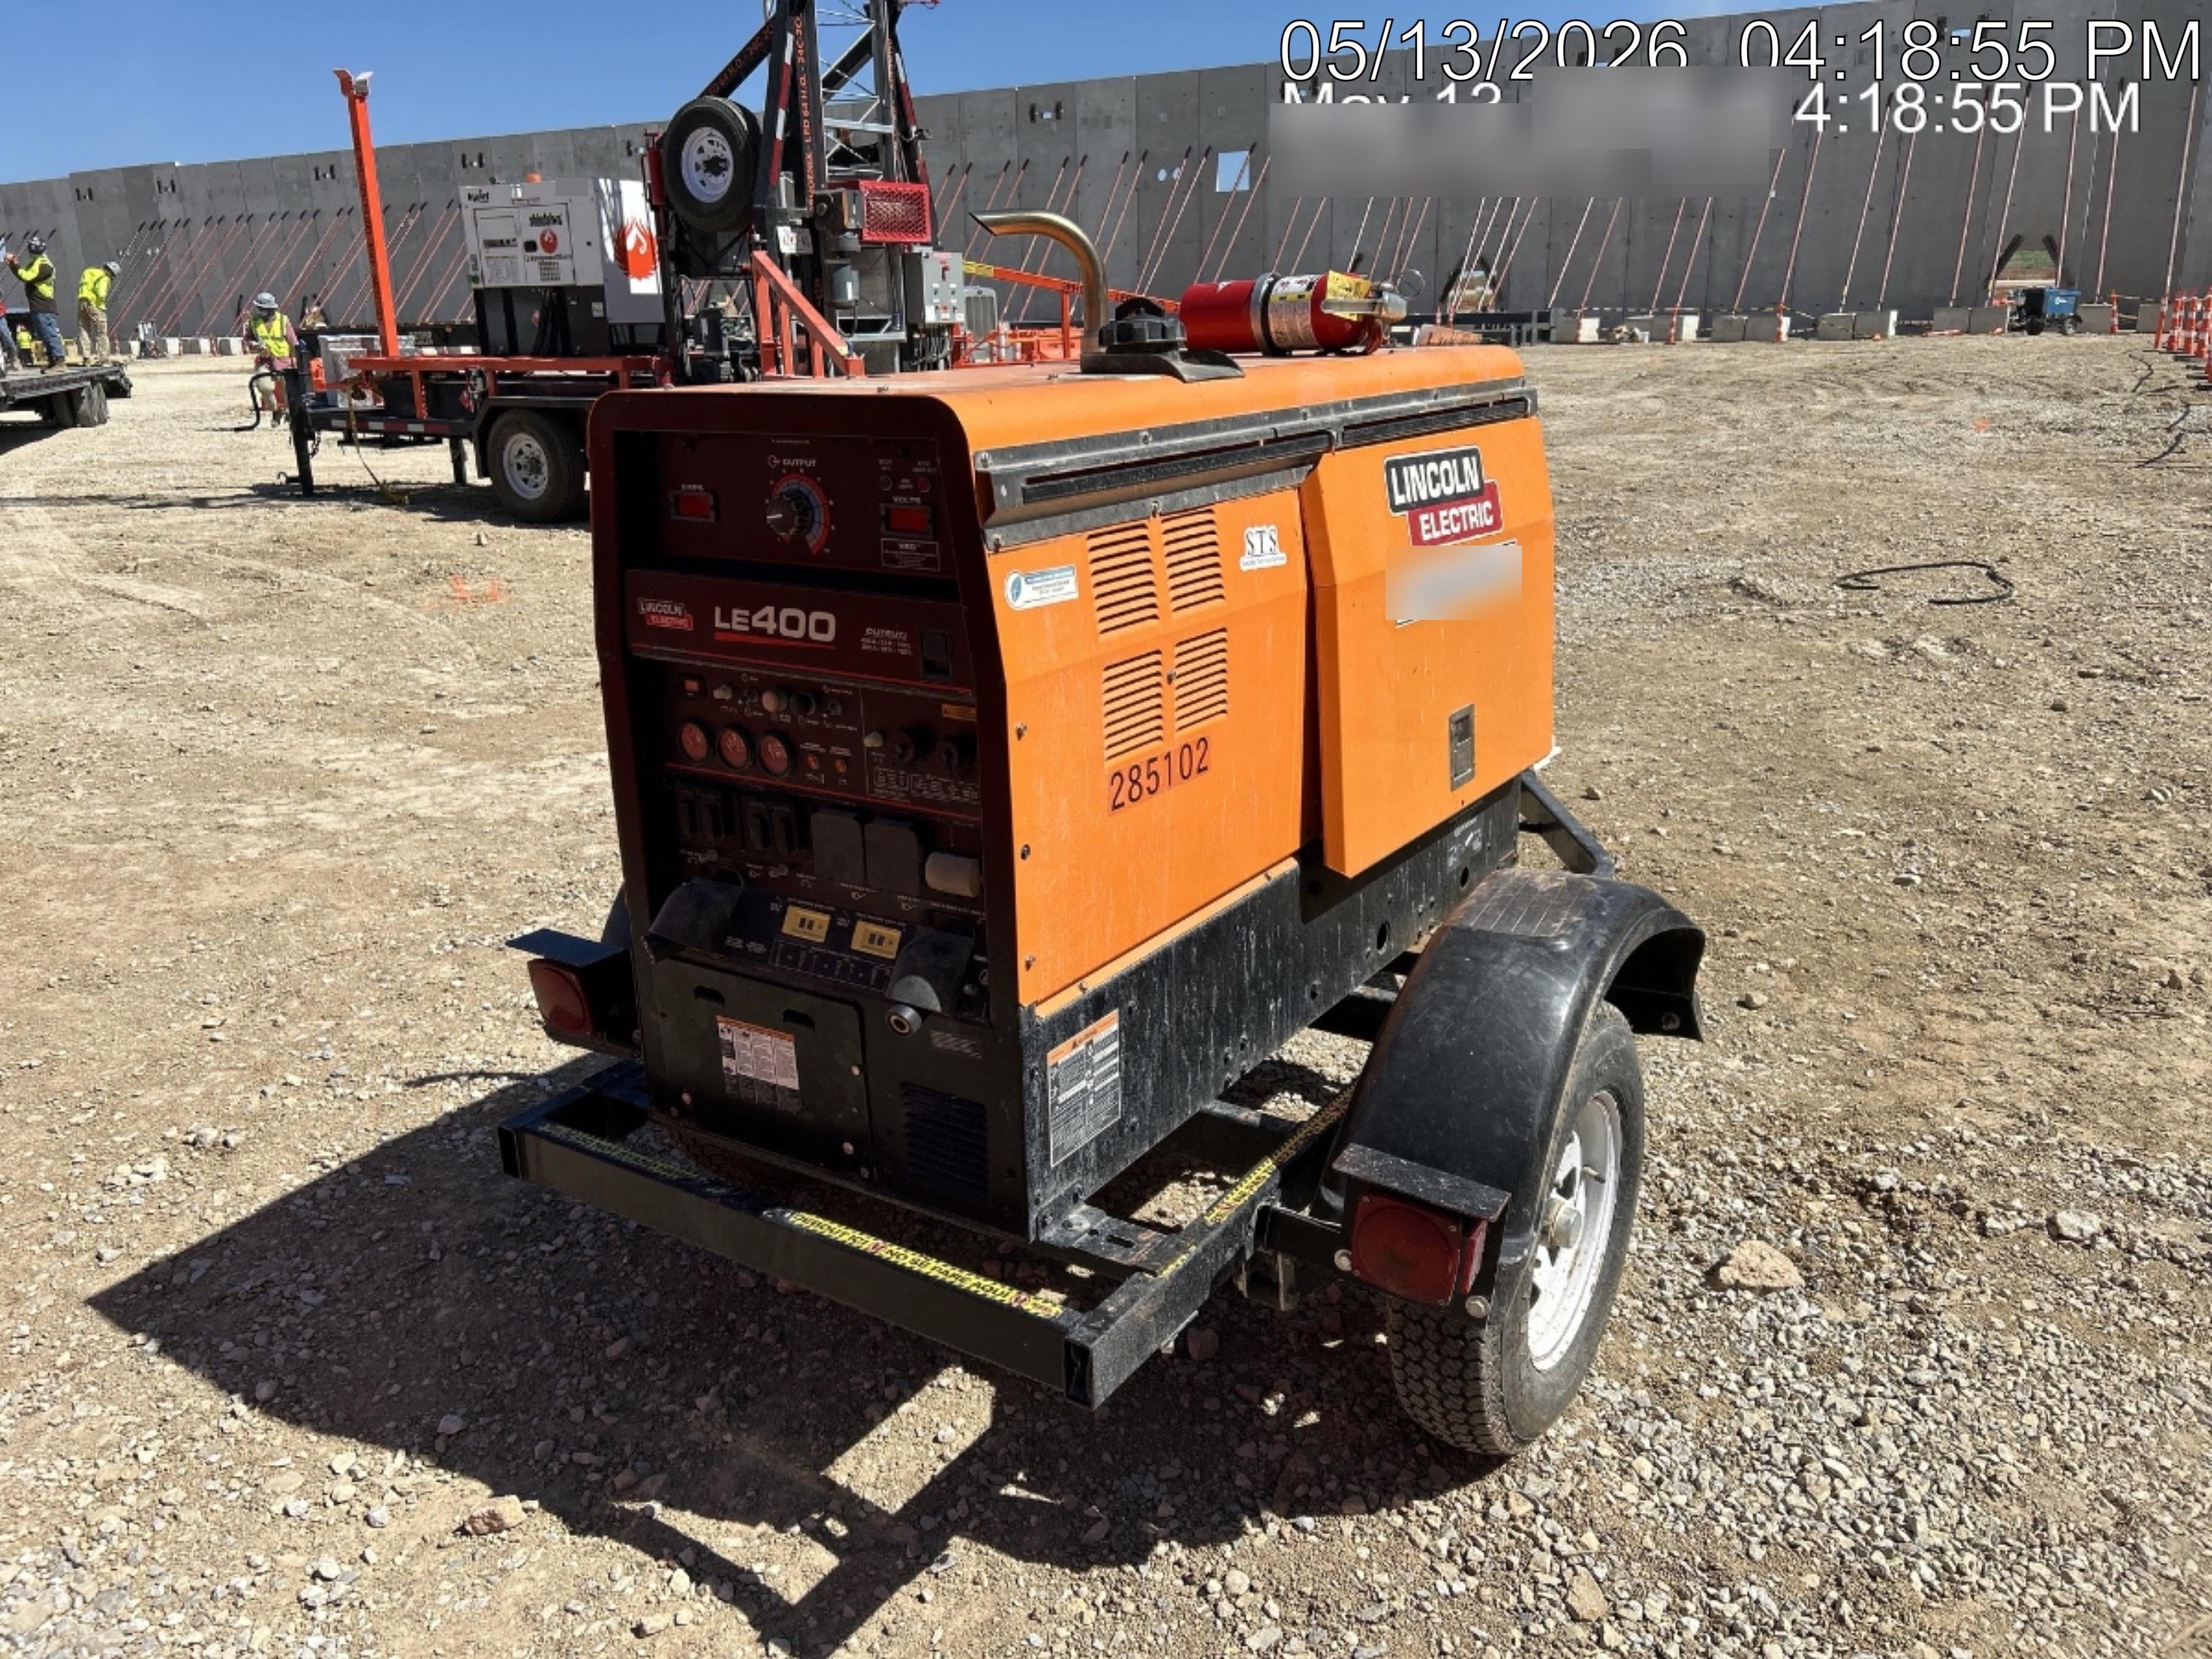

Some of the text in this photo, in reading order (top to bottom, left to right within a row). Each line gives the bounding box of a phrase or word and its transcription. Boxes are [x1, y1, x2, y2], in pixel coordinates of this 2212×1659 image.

[1390, 455, 1480, 506] LINCOLN
[1419, 501, 1494, 541] ELECTRIC
[641, 602, 683, 616] LINCOLN
[714, 605, 836, 643] LE400
[1110, 737, 1209, 812] 285102
